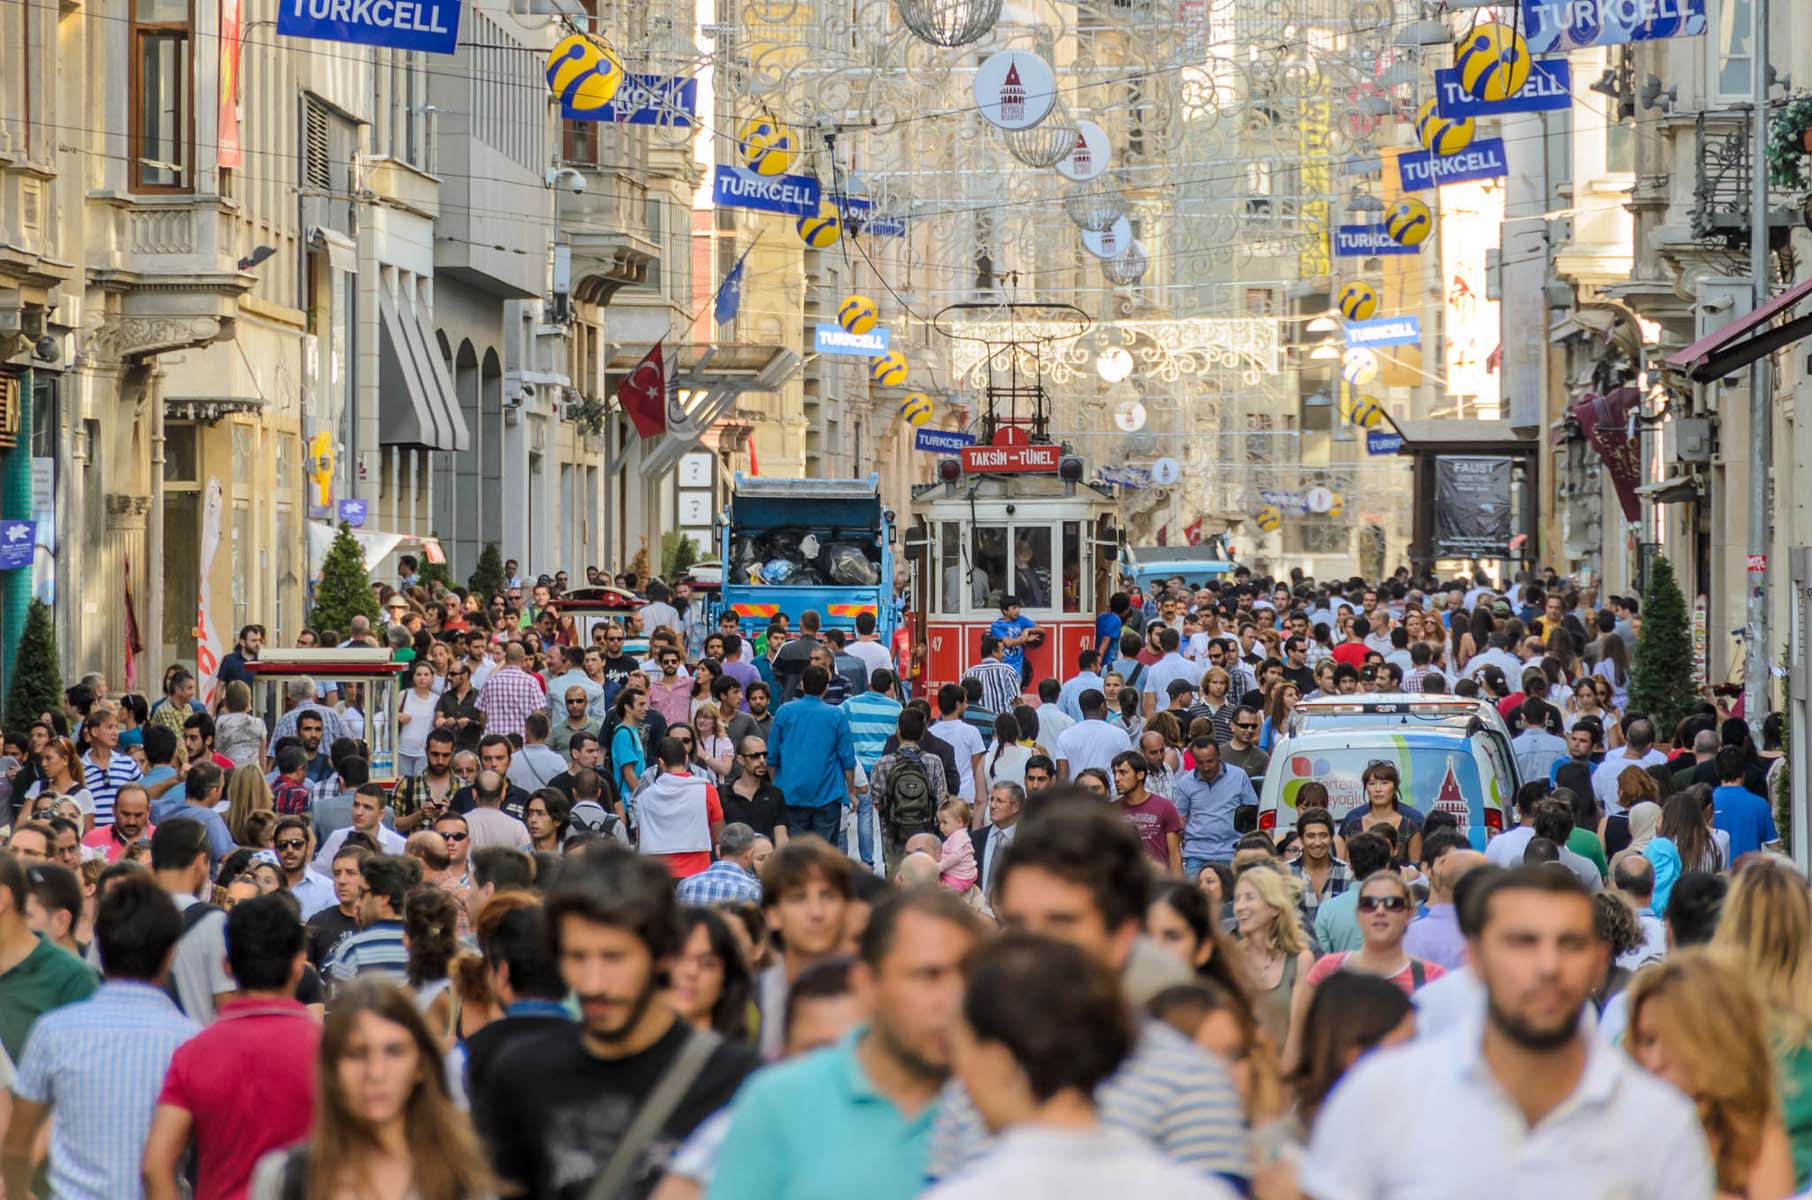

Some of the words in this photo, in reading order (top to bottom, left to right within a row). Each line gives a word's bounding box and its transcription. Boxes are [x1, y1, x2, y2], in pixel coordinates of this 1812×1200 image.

[294, 0, 448, 34] TURKCELL
[1531, 0, 1695, 32] TURKCELL
[1403, 150, 1502, 180] TURKCELL
[719, 176, 814, 206] TURKCELL
[1007, 427, 1013, 445] 1
[1454, 463, 1494, 473] FAUST
[932, 636, 943, 652] 47
[1080, 635, 1090, 648] 47
